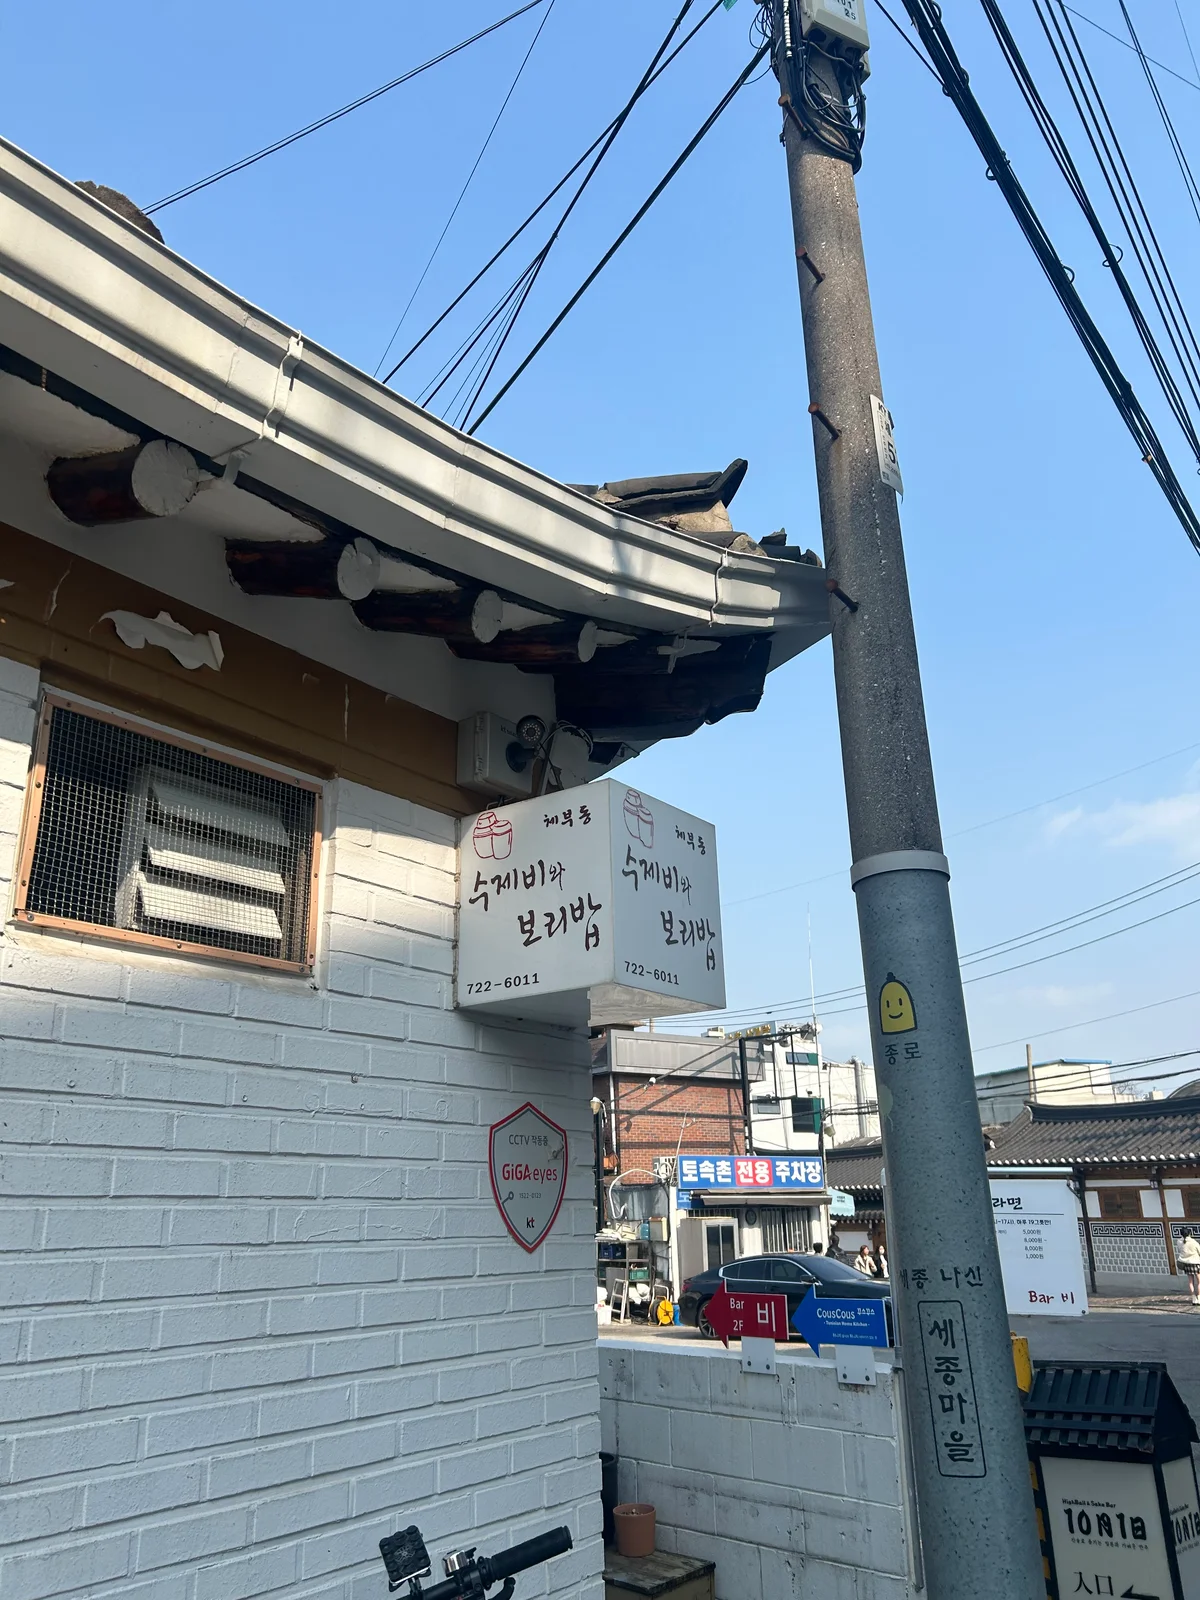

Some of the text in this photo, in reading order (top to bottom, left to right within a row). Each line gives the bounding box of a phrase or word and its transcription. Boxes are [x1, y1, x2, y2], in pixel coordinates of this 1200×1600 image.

[844, 8, 856, 20] 25
[543, 805, 592, 828] 체부동
[675, 825, 706, 855] 체부동
[469, 860, 566, 911] 수제비와
[622, 844, 692, 905] 수제비와
[517, 893, 602, 951] 보리밥
[660, 910, 716, 971] 보리밥
[467, 972, 540, 995] 722-6011
[624, 960, 680, 986] 722-6011
[885, 1042, 921, 1065] 종로
[508, 1134, 549, 1147] CCTV 작동중
[682, 1160, 822, 1184] 토속촌 전용 주차장
[991, 1197, 1023, 1210] 라면
[526, 1216, 535, 1229] kt
[940, 1266, 984, 1289] 나신
[729, 1298, 745, 1310] Bar
[1028, 1290, 1075, 1304] Bar 비
[733, 1319, 744, 1331] 2F
[756, 1301, 776, 1332] 비
[817, 1308, 856, 1320] CousCous
[929, 1318, 974, 1463] 세종마을
[1105, 1501, 1116, 1509] Bar
[1073, 1571, 1114, 1596] 入口
